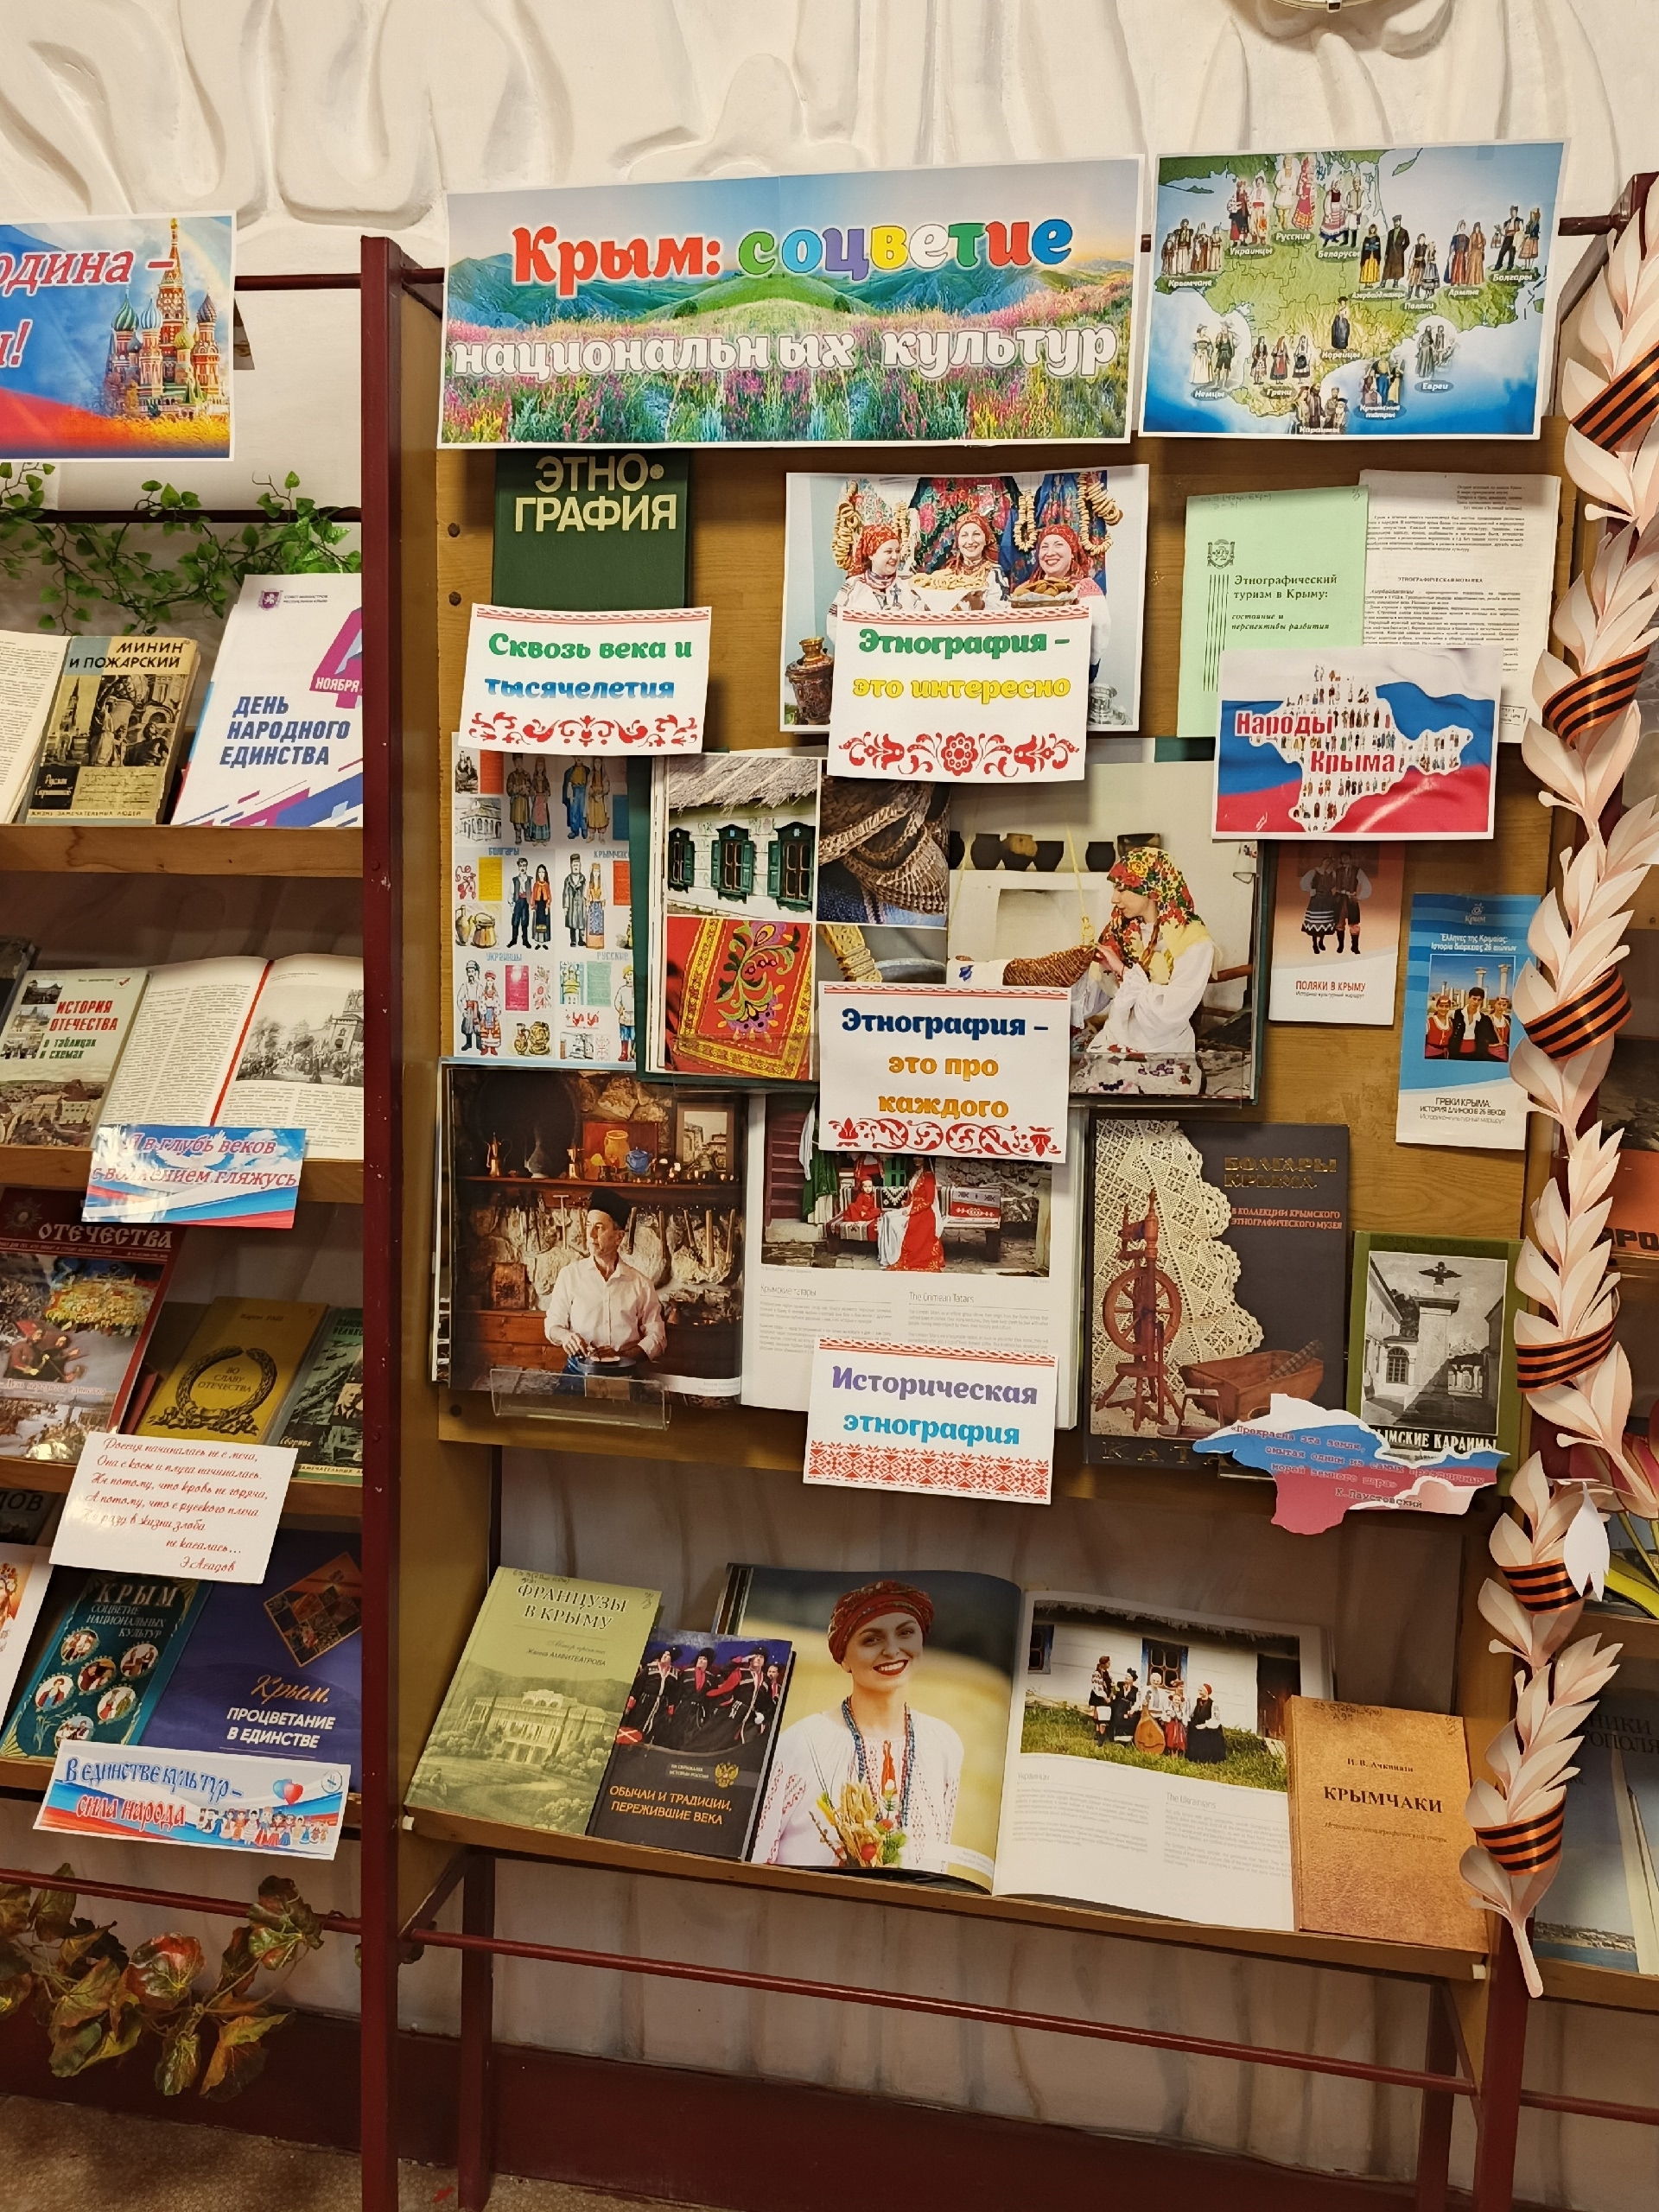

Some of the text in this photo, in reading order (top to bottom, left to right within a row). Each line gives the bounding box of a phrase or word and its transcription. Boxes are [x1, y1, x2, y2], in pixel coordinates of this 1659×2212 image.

[512, 218, 1073, 296] Крым: соцветие
[1230, 247, 1273, 257] Украинцы
[453, 327, 1117, 382] национальных культур
[1195, 391, 1224, 399] Немцы
[1422, 382, 1449, 391] Евреи
[515, 494, 677, 532] ГРАФИЯ
[1234, 574, 1338, 588] Этнографический
[1233, 588, 1329, 602] туризм в Крыму:
[1230, 620, 1330, 632] перспективы развития
[1231, 612, 1276, 621] состояние
[116, 642, 183, 654] МИНИН
[488, 632, 692, 659] Сквозь века и
[859, 628, 1047, 659] Этнография
[69, 654, 180, 671] И ПОЖАРСКИЙ
[315, 677, 360, 692] НОЯБРЯ
[484, 677, 675, 699] тысячелетия
[853, 677, 1071, 705] это интересно
[232, 696, 289, 718] ДЕНЬ
[226, 720, 352, 743] НАРОДНОГО
[1236, 713, 1333, 736] Народы
[219, 746, 330, 768] ЕДИНСТВА
[1310, 750, 1395, 775] Крыма
[1296, 981, 1366, 992] ПОЛЯКИ В КРЫМУ
[56, 1001, 113, 1014] ИСТОРИЯ
[49, 1018, 119, 1032] ОТЕЧЕСТВА
[842, 1007, 1026, 1040] Этнография
[54, 1037, 97, 1048] таблицах
[49, 1051, 84, 1059] схемах
[888, 1055, 999, 1082] это про
[878, 1095, 1008, 1119] каждого
[1436, 1097, 1460, 1106] ГРЕКИ
[143, 1139, 156, 1151] в
[157, 1135, 214, 1156] глубь
[218, 1139, 276, 1154] веков
[1224, 1157, 1337, 1173] БОЛГАРЫ
[215, 1171, 297, 1190] гляжусь
[1238, 1207, 1287, 1217] КОЛЛЕКЦИИ
[1289, 1210, 1340, 1218] КРЫМСКОГО
[1231, 1217, 1342, 1230] ЭТНОГРАФИЧЕСКОГО МУЗЕЯ
[38, 1223, 173, 1249] ОТЕЧЕСТВА
[760, 1284, 792, 1295] Крымские
[909, 1291, 975, 1303] The Crimean Tatars
[198, 1382, 251, 1392] ОТЕЧЕСТВА
[832, 1366, 1038, 1404] Историческая
[842, 1414, 1020, 1446] этнография
[104, 1438, 143, 1452] Россия
[144, 1445, 206, 1458] начиналась
[208, 1450, 218, 1459] не
[229, 1451, 258, 1463] меча,
[280, 1435, 313, 1448] Сборник
[1301, 1436, 1365, 1452] эта земля,
[1434, 1433, 1497, 1452] КАРАИМЫ
[97, 1455, 118, 1469] Она
[129, 1458, 154, 1471] косы
[156, 1462, 163, 1471] и
[164, 1462, 195, 1476] плуга
[197, 1466, 263, 1480] начиналась.
[1265, 1446, 1485, 1484] омытая одним из самых праздничных
[109, 1476, 155, 1492] потому,
[158, 1482, 179, 1491] что
[181, 1480, 212, 1495] кровь
[214, 1486, 226, 1496] не
[1310, 1469, 1357, 1483] земного
[1363, 1477, 1397, 1489] шара»
[86, 1491, 99, 1503] А
[99, 1494, 145, 1510] потому,
[149, 1500, 170, 1510] что
[179, 1500, 225, 1516] русского
[227, 1507, 259, 1517] плеча
[99, 1512, 207, 1532] разу в жизни злоба
[166, 1539, 177, 1548] не
[94, 1584, 179, 1606] КРЫМ
[518, 1583, 627, 1612] ФРАНЦУЗЫ
[91, 1604, 139, 1615] СОЦВЕТИЕ
[524, 1605, 613, 1630] В КРЫМУ
[86, 1614, 166, 1628] НАЦИОНАЛЬНЫХ
[118, 1627, 162, 1638] КУЛЬТУР
[550, 1651, 606, 1666] АМФИТЕАТРОВА
[226, 1707, 335, 1730] ПРОЦВЕТАНИЕ
[226, 1726, 320, 1749] В ЕДИНСТВЕ
[64, 1757, 160, 1786] В единстве
[609, 1785, 733, 1812] ОБЫЧАИ И ТРАДИЦИИ,
[1166, 1792, 1217, 1809] The Ukrainians
[1324, 1786, 1443, 1813] КРЫМЧАКИ
[76, 1795, 186, 1835] сила народа
[611, 1801, 722, 1824] ПЕРЕЖИВШИЕ ВЕКА
